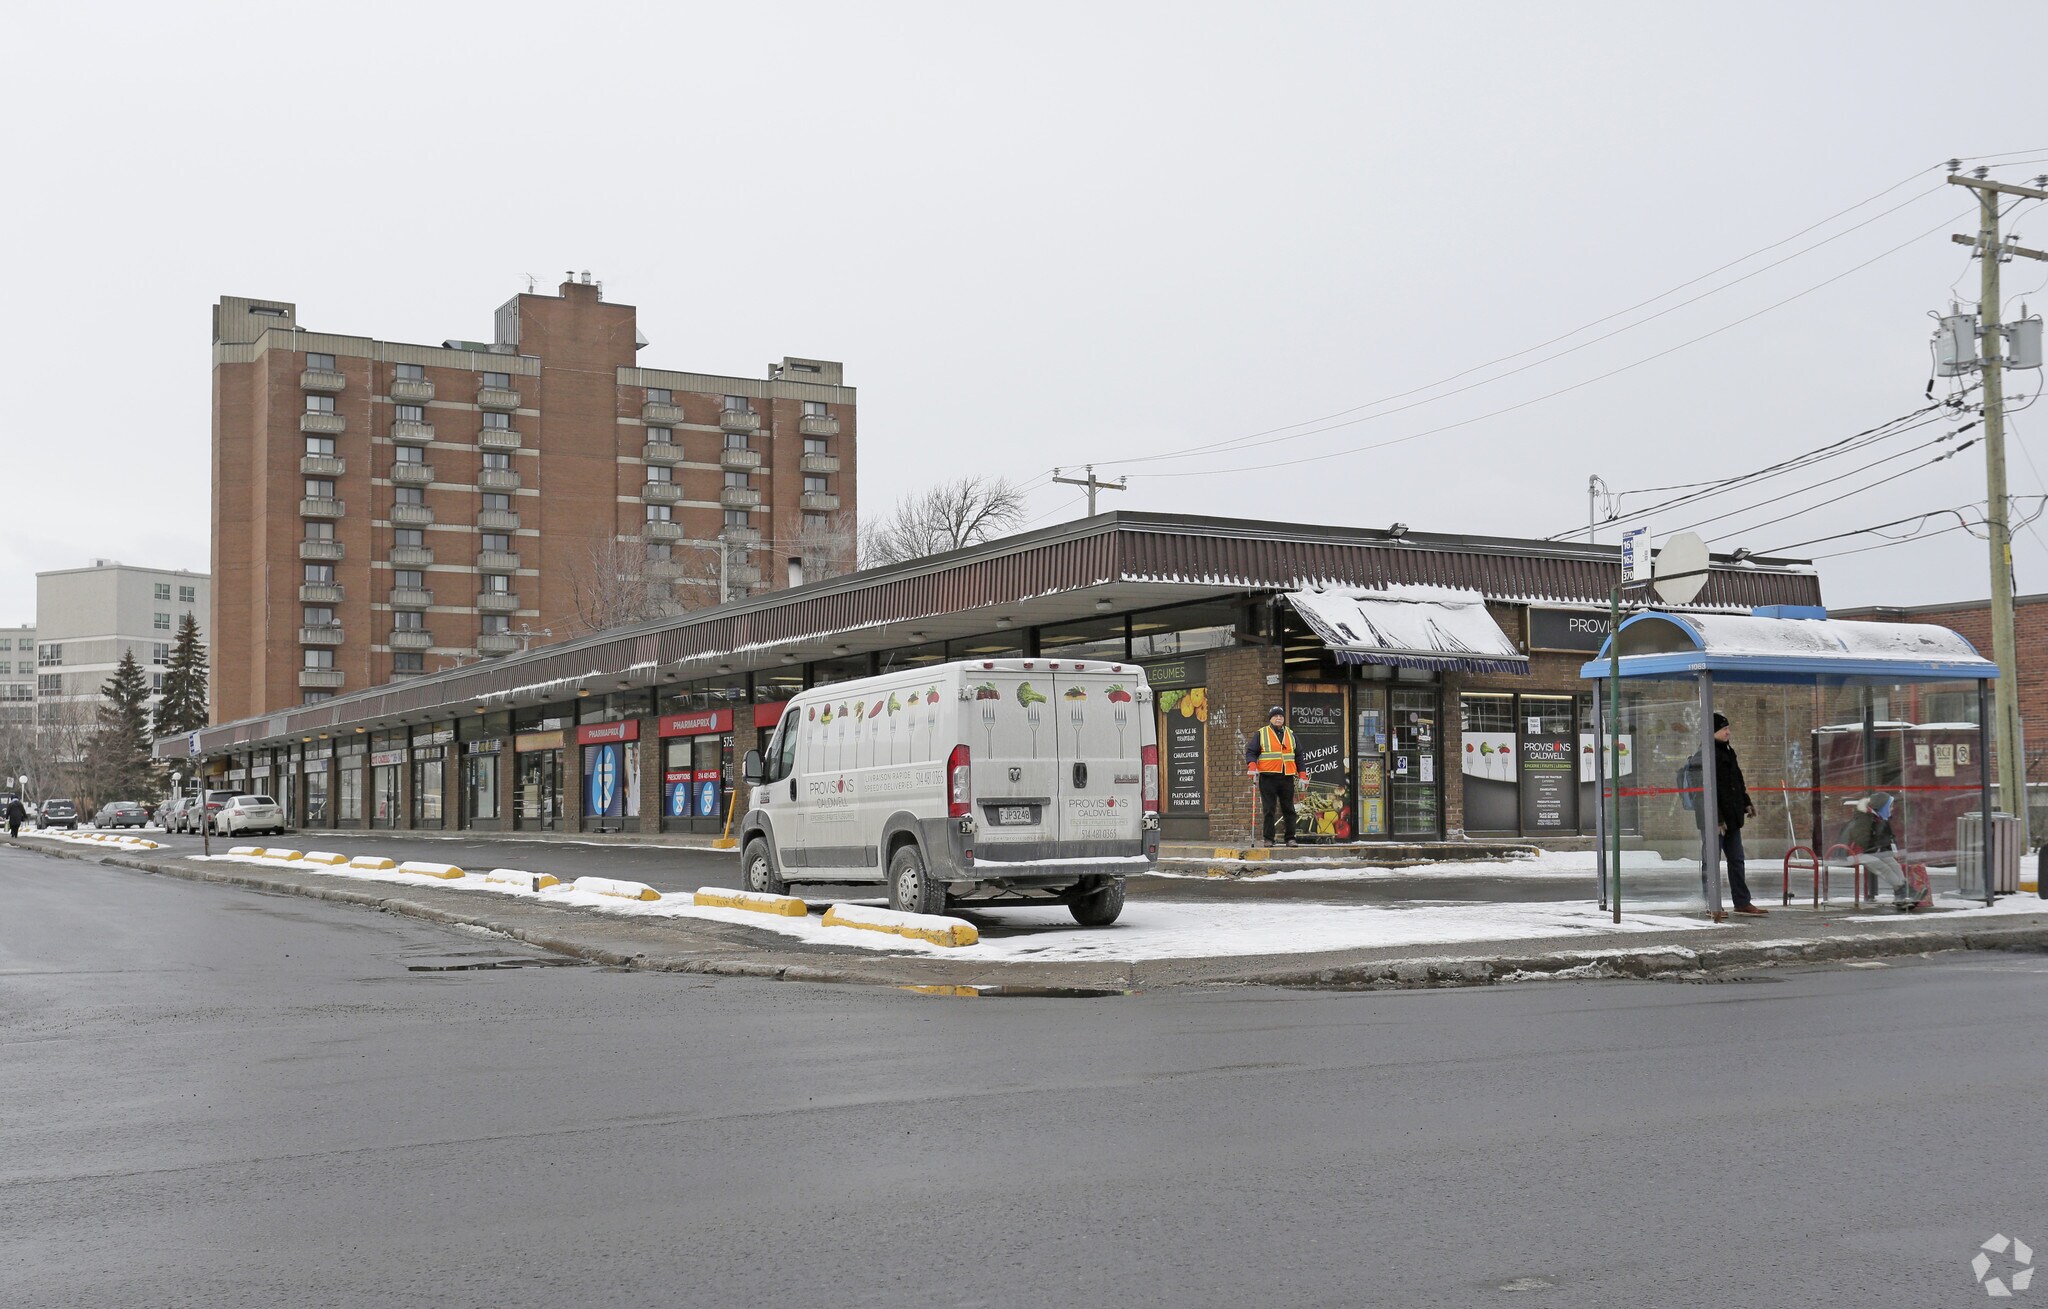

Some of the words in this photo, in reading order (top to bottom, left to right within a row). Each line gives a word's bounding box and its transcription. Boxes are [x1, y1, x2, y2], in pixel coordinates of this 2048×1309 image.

[1623, 539, 1634, 550] 161
[1623, 554, 1634, 565] 162
[1623, 570, 1634, 581] 370
[1148, 666, 1186, 681] LÉGUMES
[673, 717, 710, 730] PHARMAPRIX
[1298, 716, 1335, 725] CALDWELL
[588, 726, 619, 739] PHARMAPRIX
[1523, 742, 1571, 752] PROVISIONS
[1530, 752, 1565, 760] CALDWELL
[1305, 760, 1339, 776] ELCOME
[865, 773, 891, 783] LIVRAISON
[892, 771, 911, 780] RAPIDE
[809, 778, 855, 796] PROVISIONS
[864, 783, 882, 793] SPEEDY
[883, 781, 913, 792] DELIVERIES
[816, 796, 849, 809] CALDWELL
[1068, 798, 1128, 808] PROVISIONS
[1000, 810, 1030, 820] FJP3248
[1077, 809, 1120, 817] CALDWELL
[1081, 829, 1091, 839] 514
[1102, 828, 1117, 839] 0365
